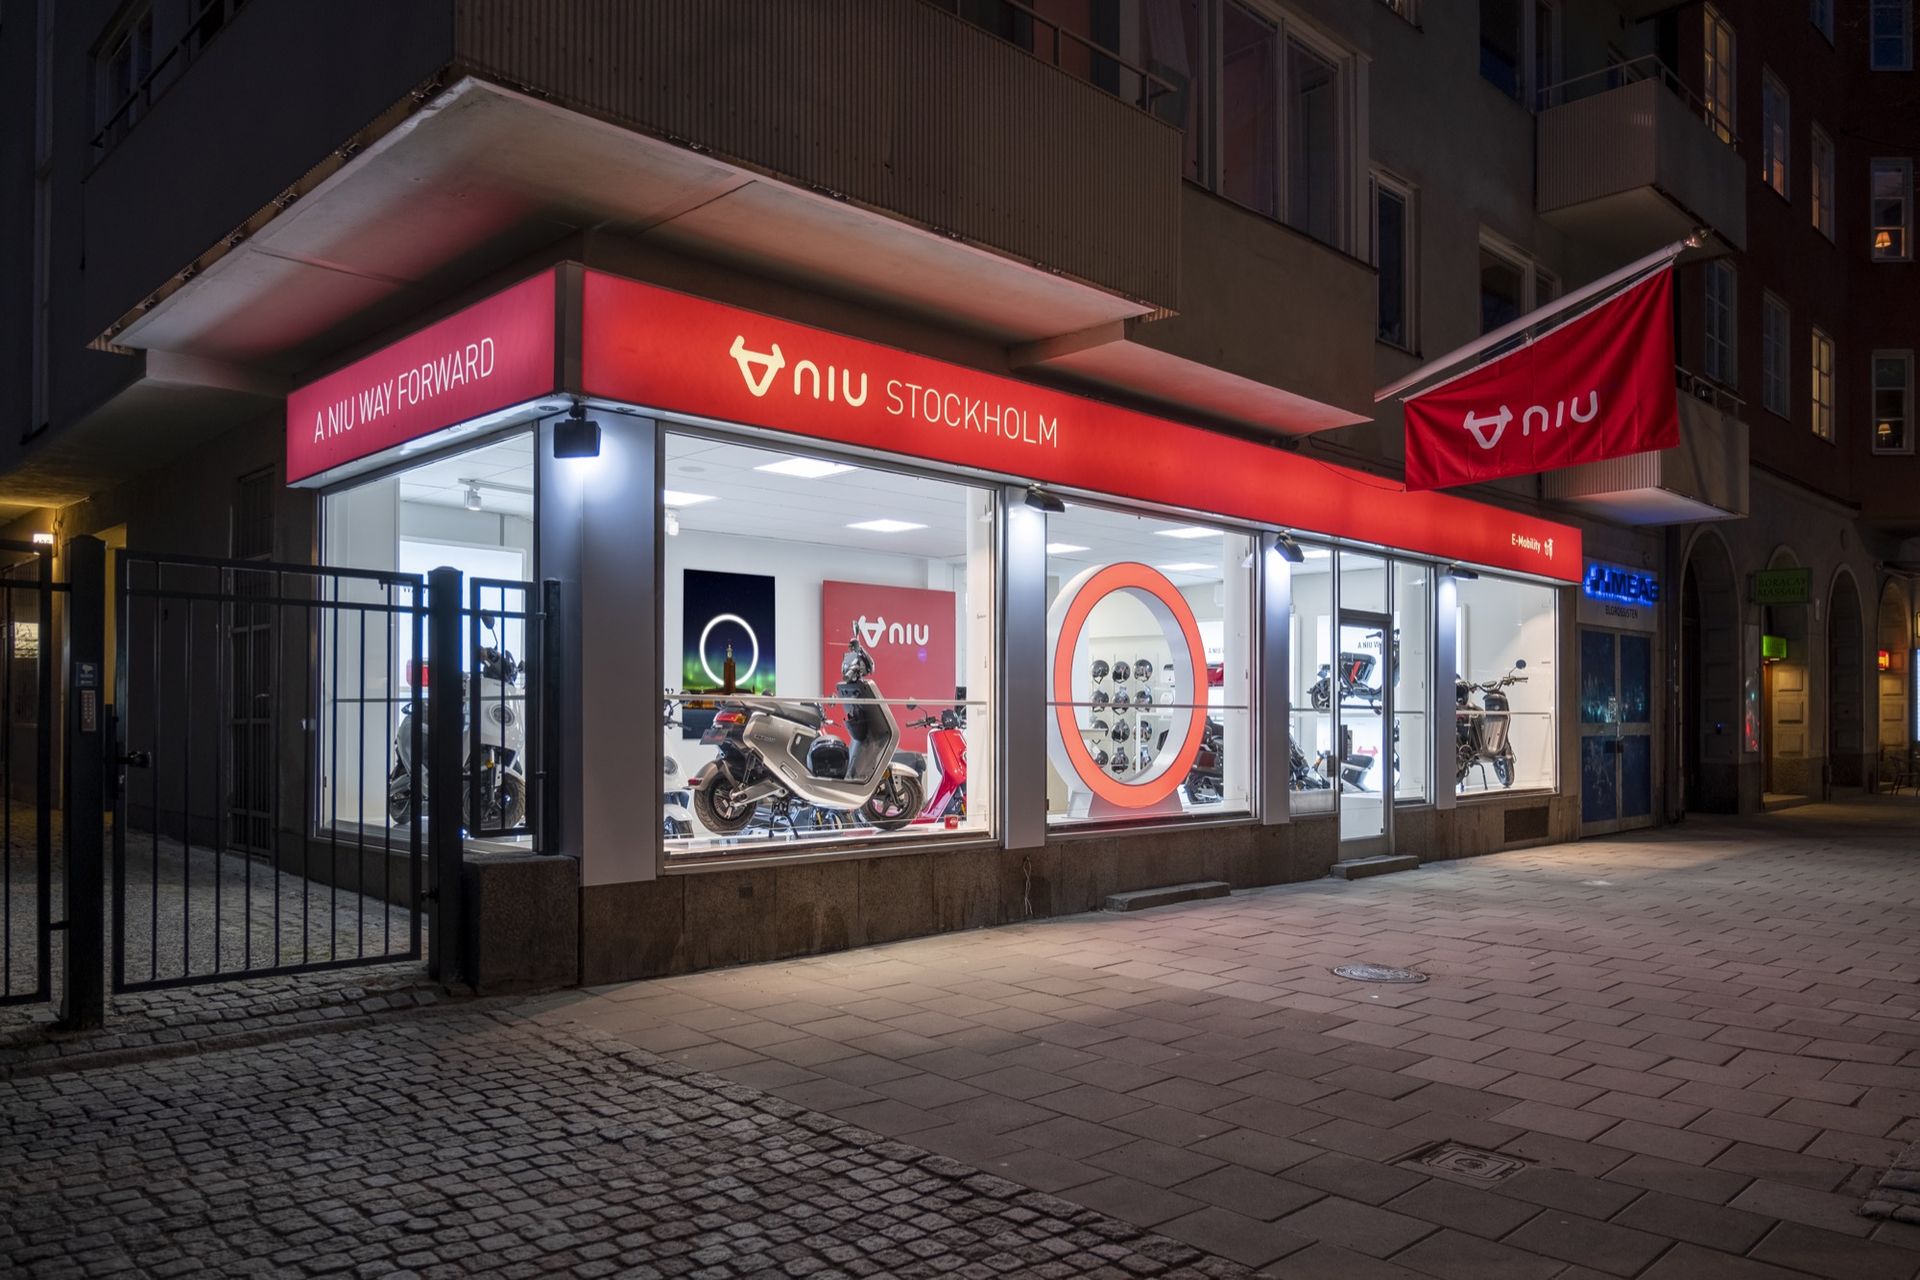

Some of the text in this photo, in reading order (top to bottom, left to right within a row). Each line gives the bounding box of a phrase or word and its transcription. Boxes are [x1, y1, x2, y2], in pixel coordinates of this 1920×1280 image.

[314, 337, 495, 443] A NIU WAY FORWARD
[886, 379, 1058, 448] STOCKHOLM
[1511, 533, 1541, 554] E-Mobility
